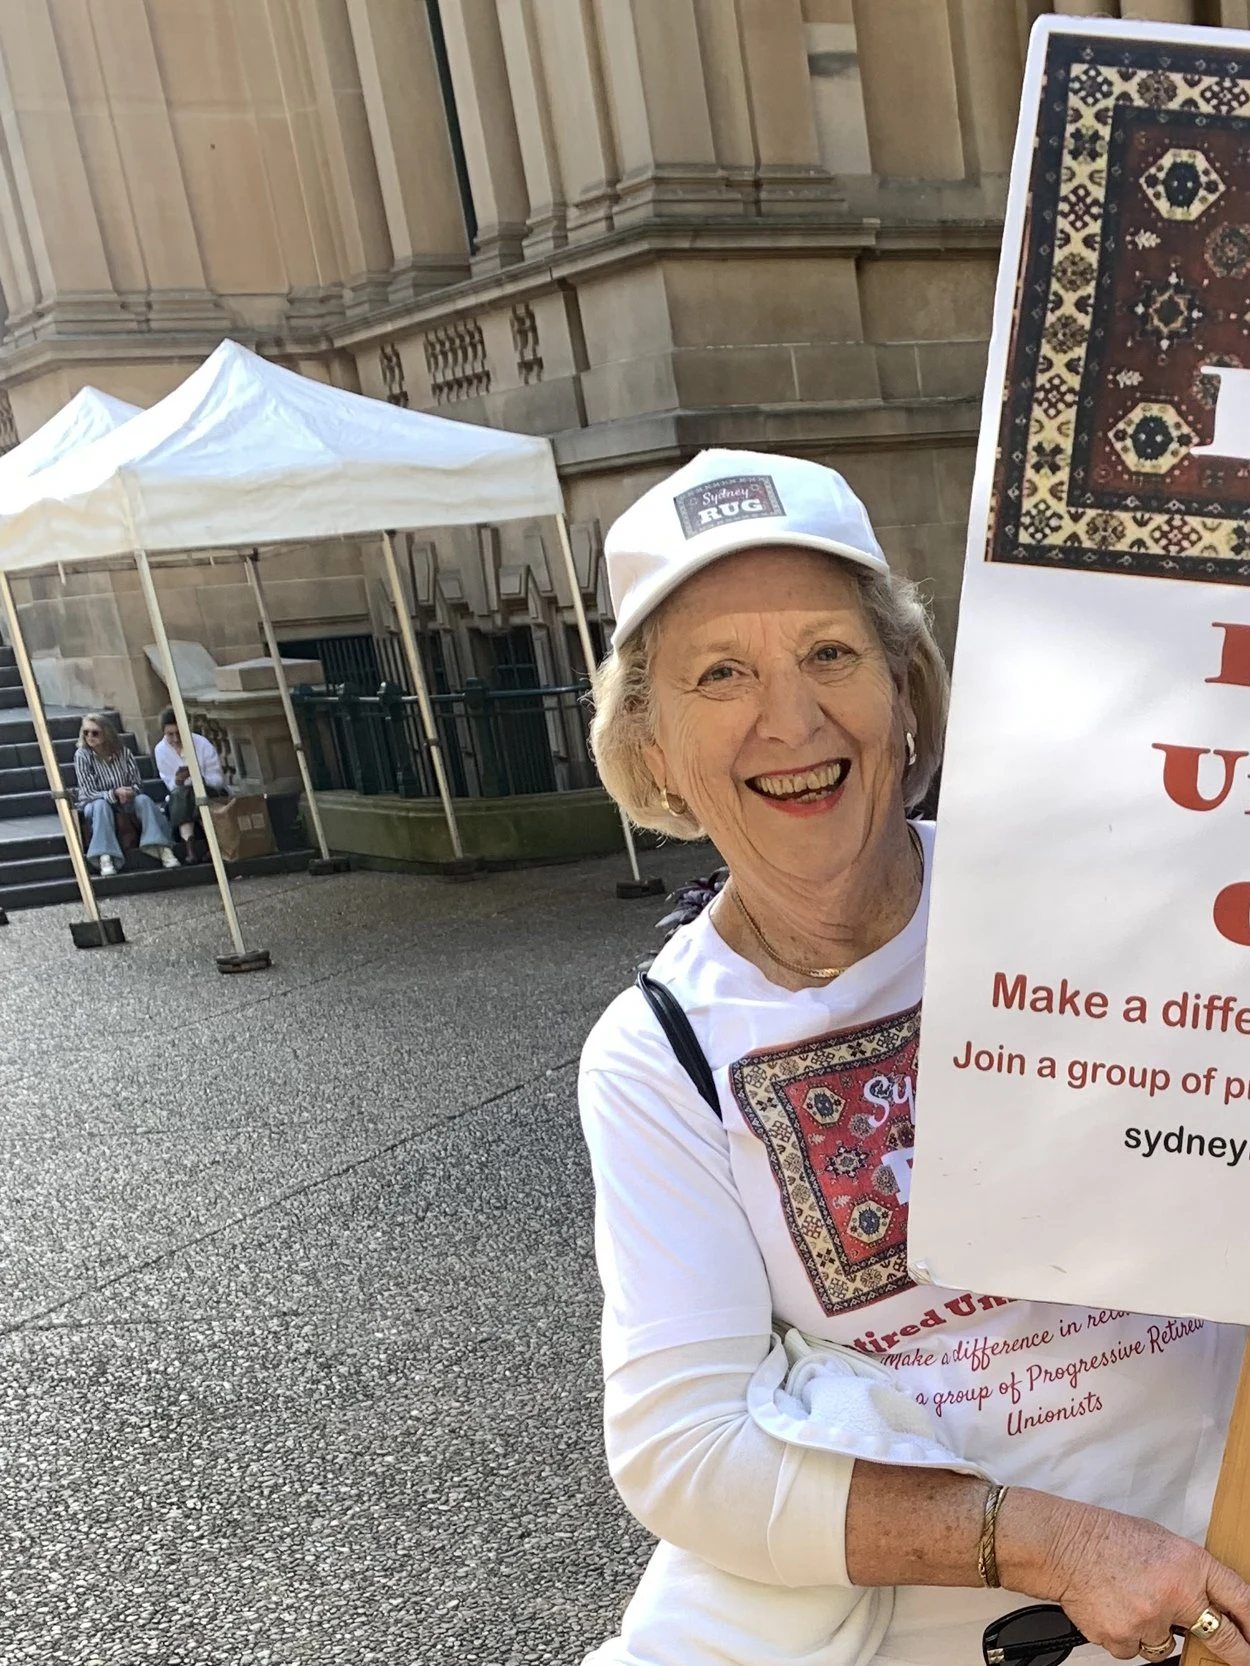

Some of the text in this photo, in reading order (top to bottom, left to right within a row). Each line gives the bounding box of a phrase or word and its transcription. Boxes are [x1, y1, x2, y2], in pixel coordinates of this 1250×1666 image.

[698, 498, 763, 524] RUG
[702, 487, 749, 506] Sydney
[991, 971, 1109, 1019] Make
[1122, 995, 1147, 1024] a
[953, 1040, 1026, 1076] Join
[1036, 1055, 1057, 1079] a
[1067, 1059, 1171, 1097] group
[1181, 1067, 1218, 1096] of
[863, 1075, 916, 1128] Sy
[853, 1293, 1018, 1352] tired Un
[880, 1348, 939, 1370] Make
[941, 1353, 950, 1366] a
[953, 1330, 1054, 1372] difference
[1059, 1319, 1082, 1338] in
[916, 1392, 930, 1405] a
[933, 1385, 993, 1418] group
[999, 1372, 1023, 1404] of
[1026, 1341, 1145, 1391] Progressive
[1007, 1391, 1103, 1436] Unionists
